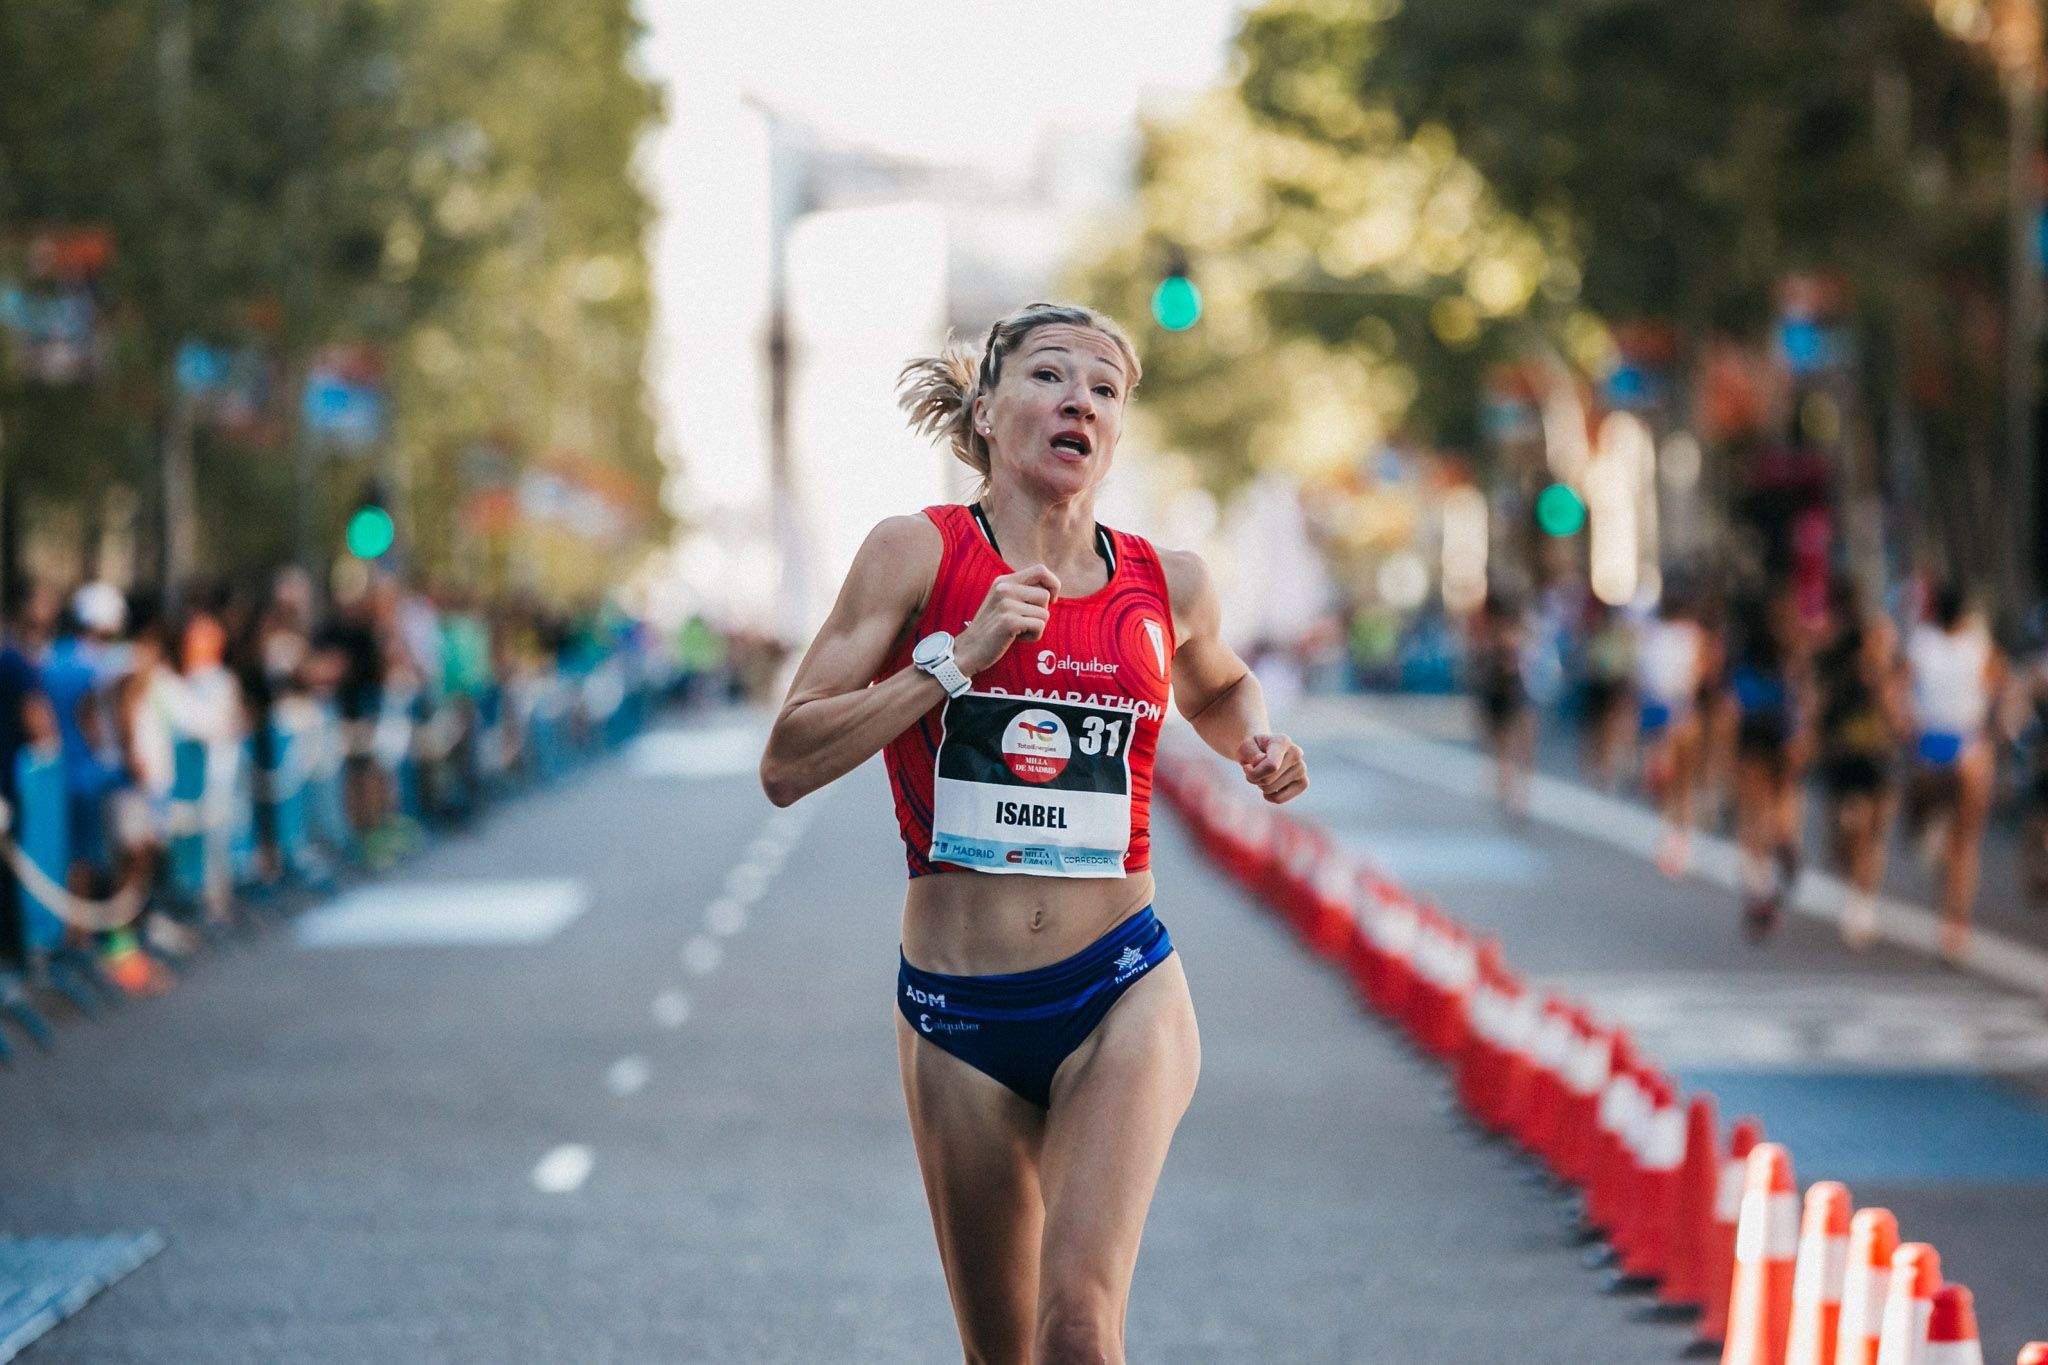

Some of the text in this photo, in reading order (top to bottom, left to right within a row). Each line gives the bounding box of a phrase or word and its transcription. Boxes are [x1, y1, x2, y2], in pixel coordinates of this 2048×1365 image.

[1057, 654, 1119, 676] alquiber
[1024, 687, 1161, 722] MARATHON
[1079, 715, 1123, 757] 31
[1015, 763, 1057, 774] DE MADRID
[1025, 756, 1048, 766] MILLA
[995, 801, 1068, 829] ISABEL
[952, 844, 995, 859] MADRID
[906, 984, 946, 1008] ADM
[932, 1018, 981, 1035] alquiber
